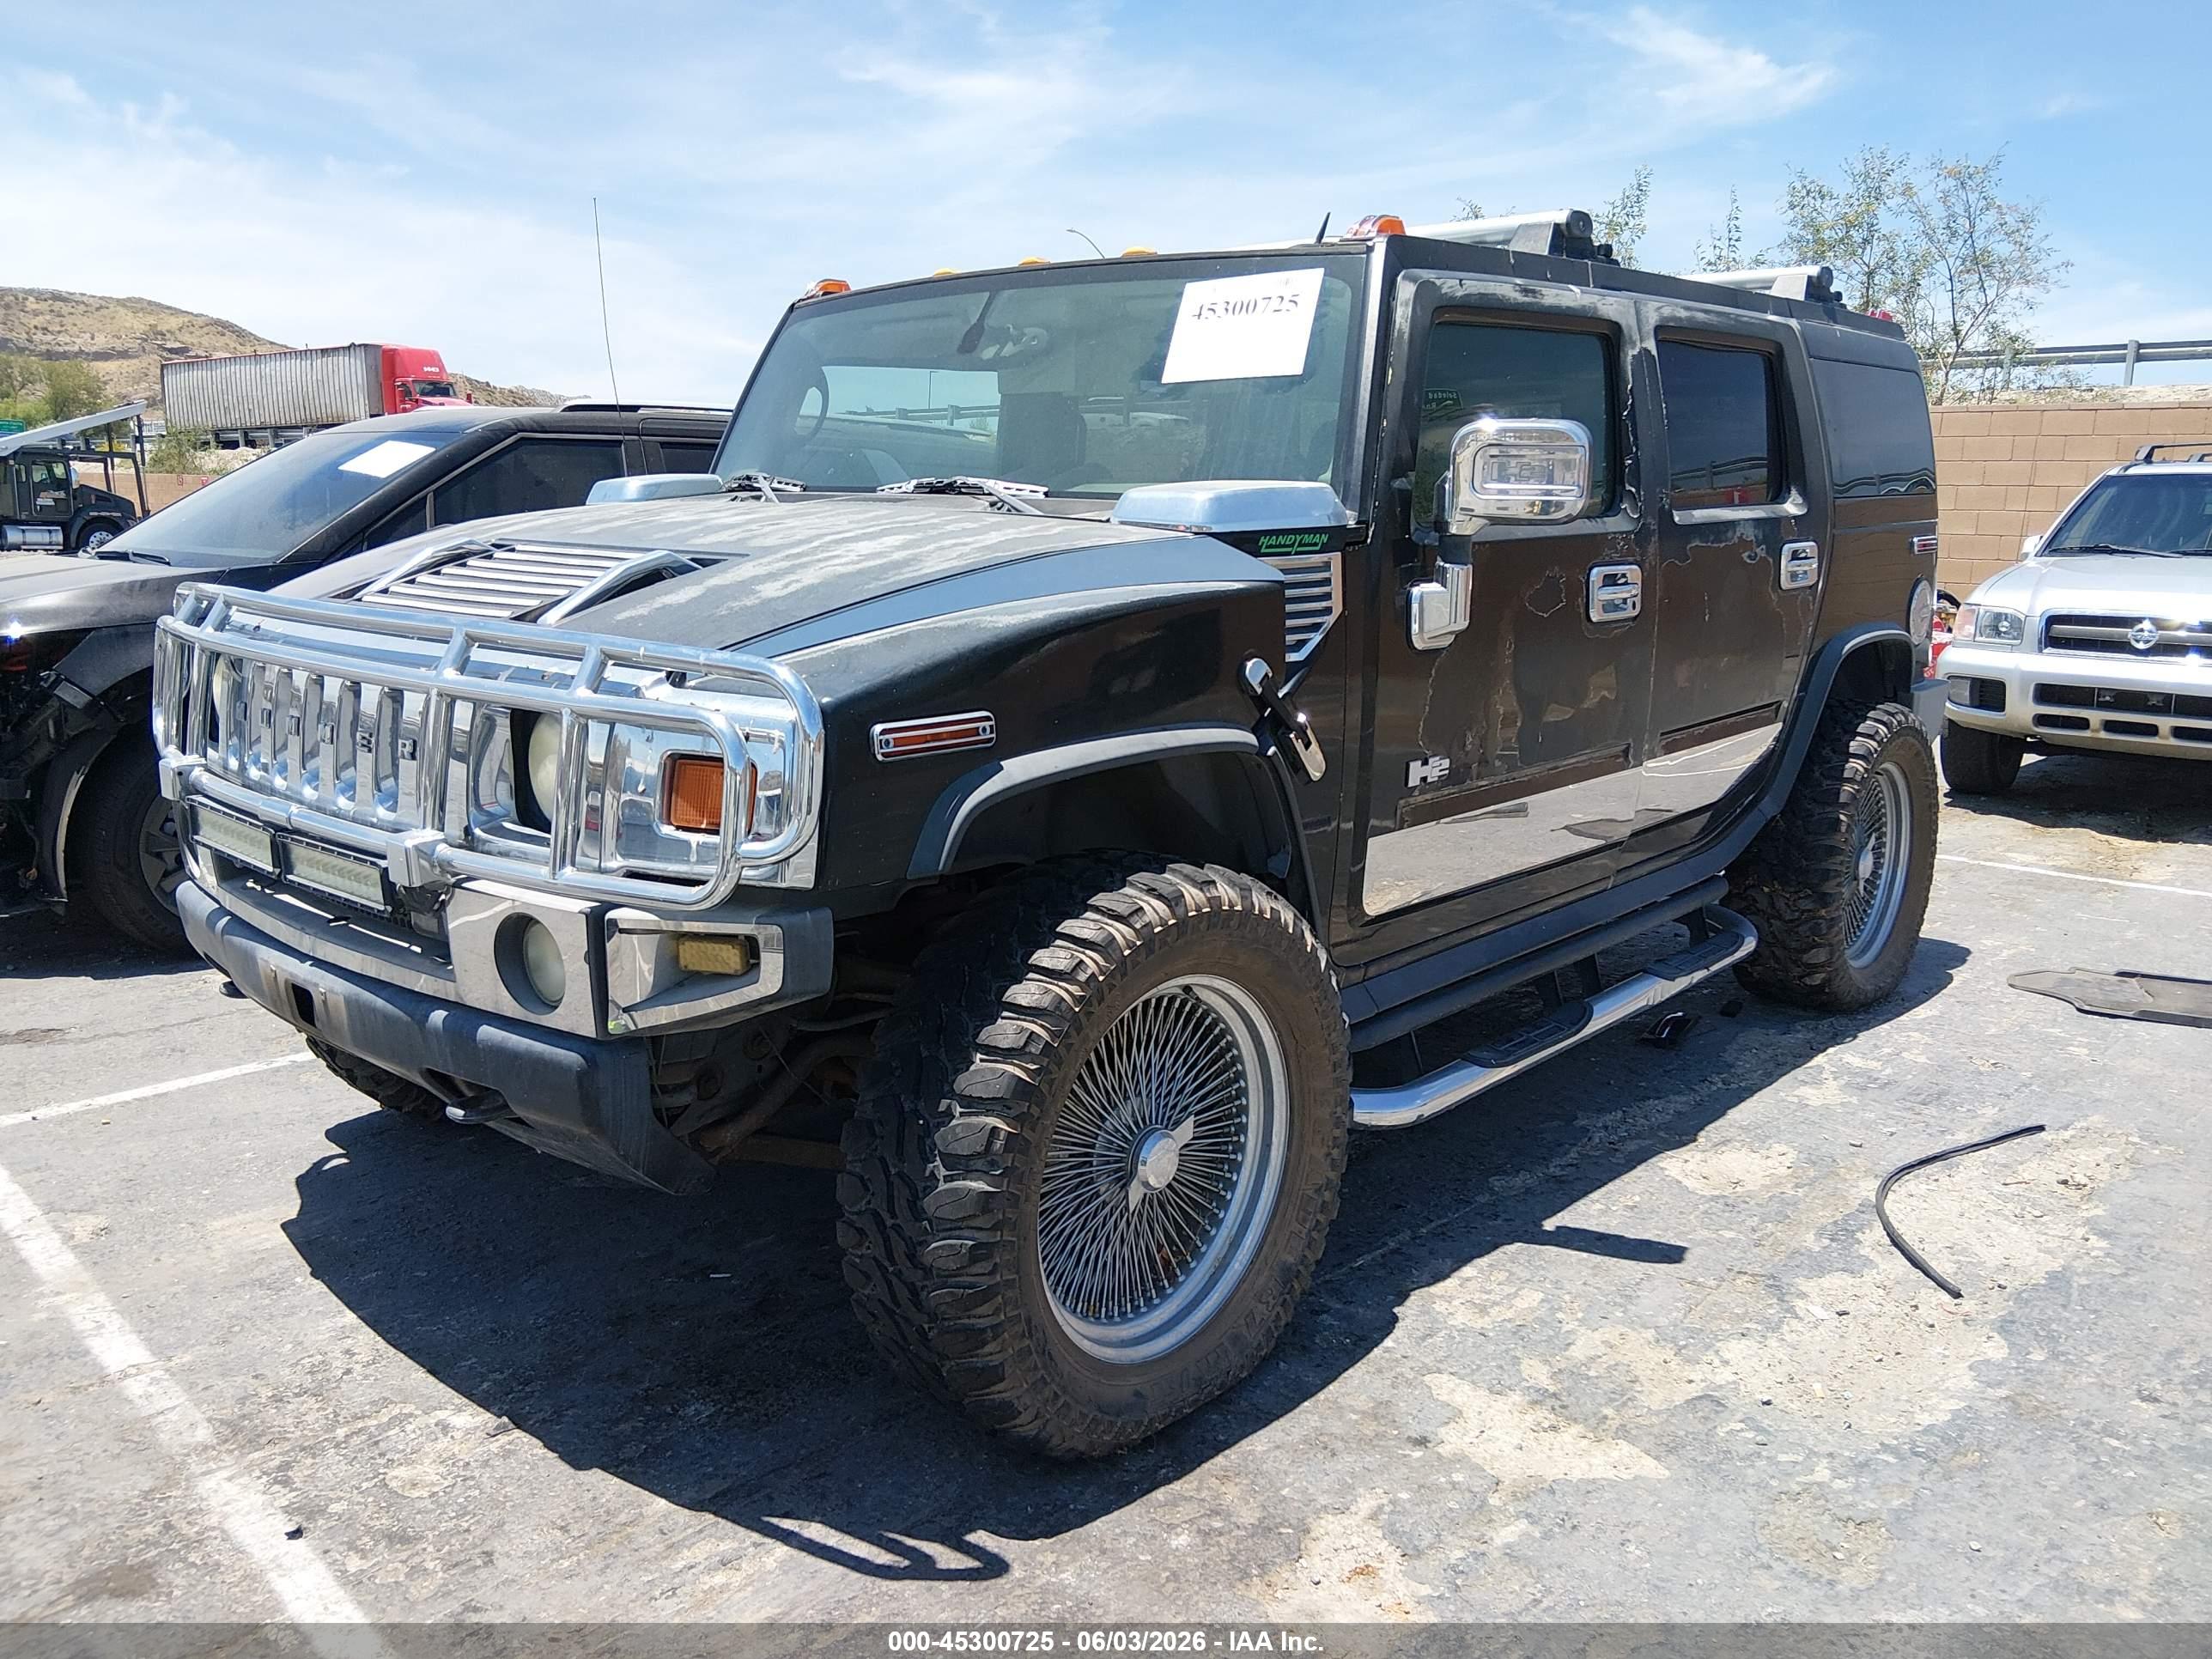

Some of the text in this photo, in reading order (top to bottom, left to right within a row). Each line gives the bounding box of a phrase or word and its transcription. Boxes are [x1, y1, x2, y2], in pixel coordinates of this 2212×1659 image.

[1191, 294, 1300, 320] 45300725
[1258, 533, 1329, 555] HANDYMAN
[1405, 756, 1450, 787] H2
